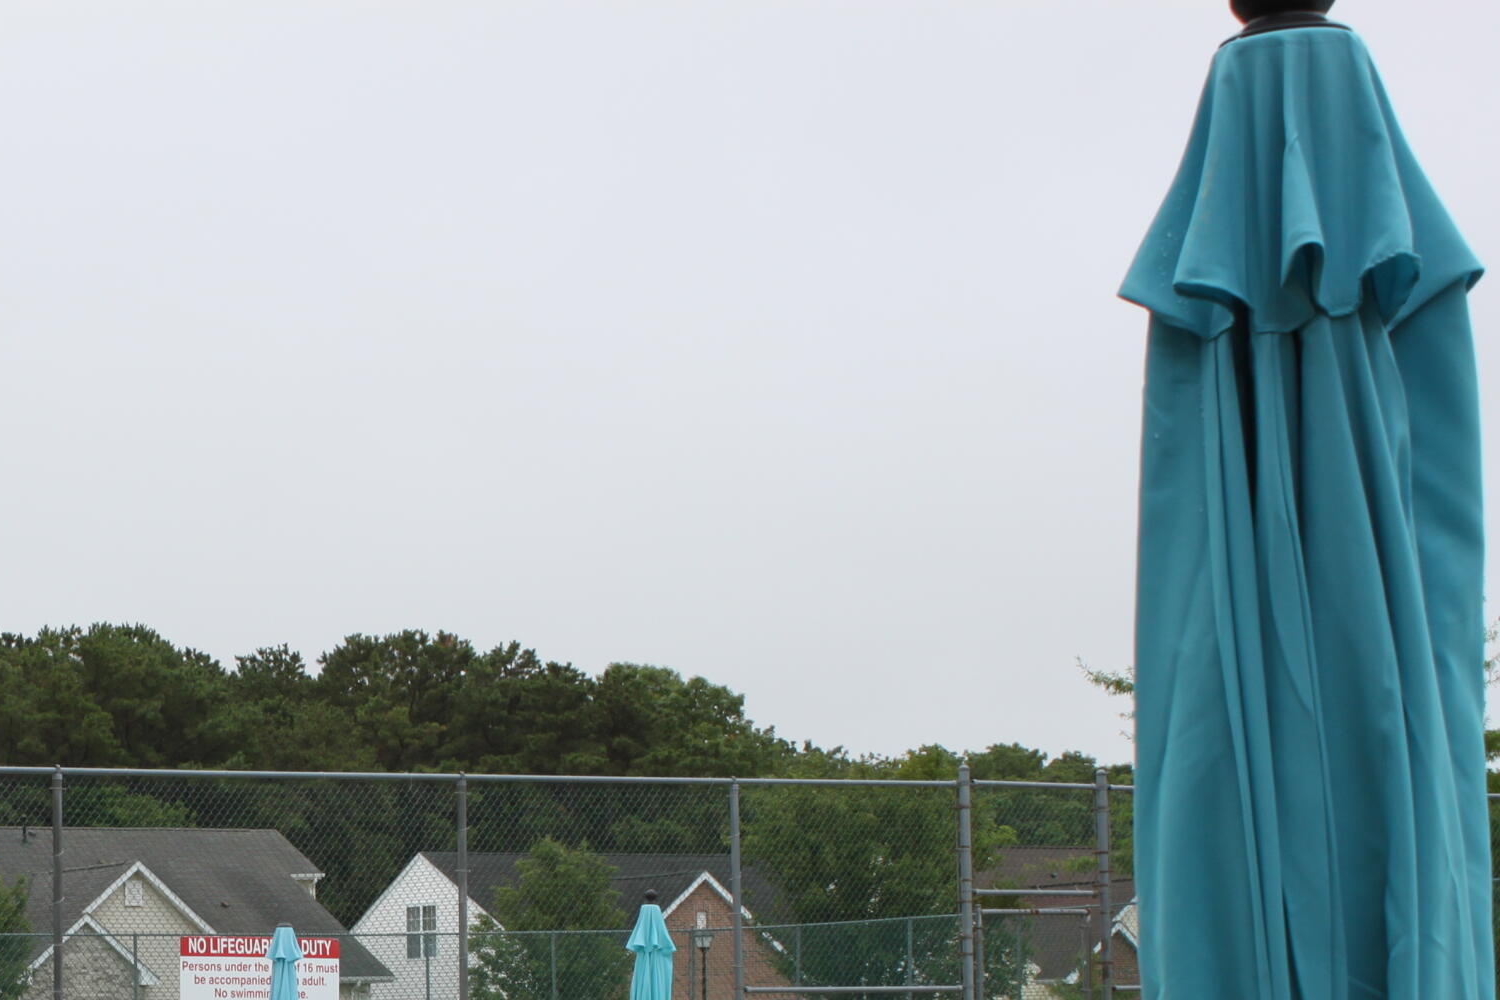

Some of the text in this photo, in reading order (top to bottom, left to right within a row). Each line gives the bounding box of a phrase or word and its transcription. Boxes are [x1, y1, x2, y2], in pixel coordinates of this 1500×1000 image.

[188, 938, 331, 956] NO LIFEGUAR DUTY
[182, 961, 221, 972] Persons
[225, 962, 251, 972] under
[255, 962, 269, 972] the
[304, 963, 313, 973] 16
[316, 964, 338, 974] must
[194, 974, 206, 985] be
[209, 975, 272, 987] accompanied
[302, 976, 327, 986] adult.
[214, 988, 271, 999] No swimmi
